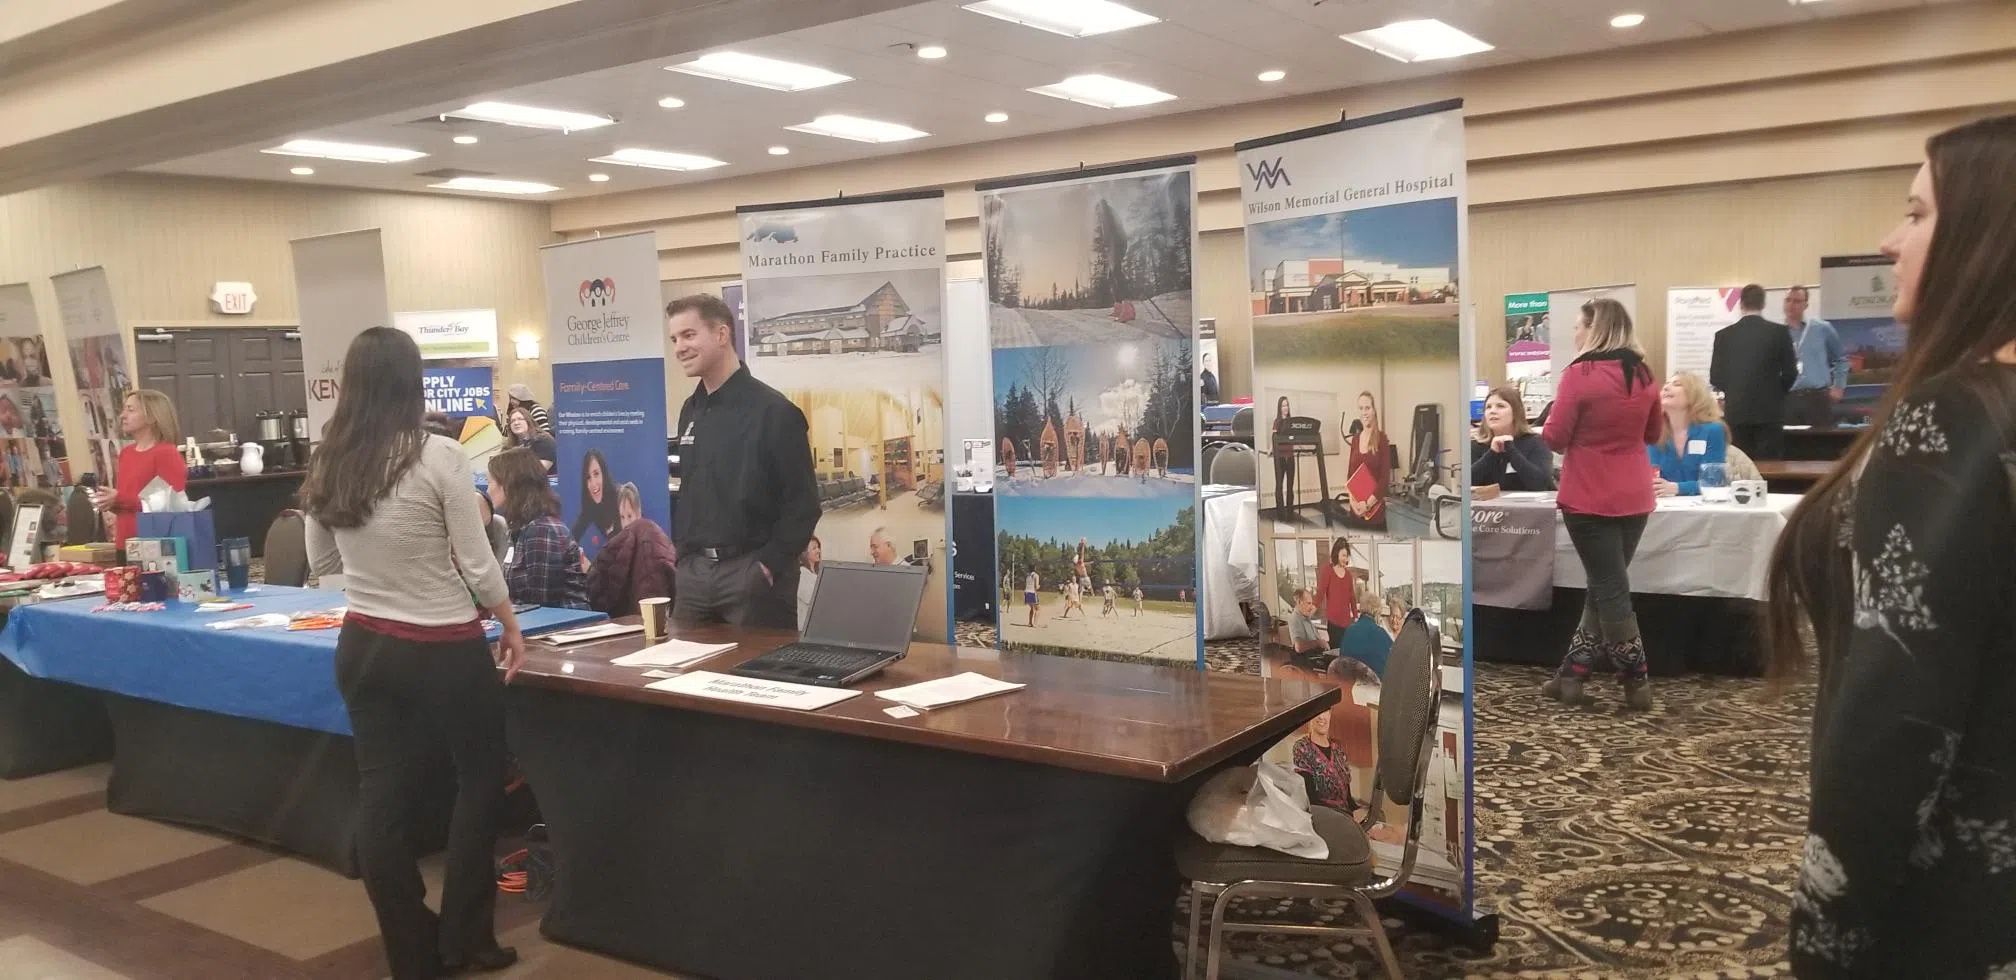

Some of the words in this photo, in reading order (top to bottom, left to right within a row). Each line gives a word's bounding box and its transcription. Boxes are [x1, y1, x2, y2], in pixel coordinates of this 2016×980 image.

[1248, 202, 1281, 215] Wilson
[1284, 191, 1339, 210] Memorial
[1344, 182, 1390, 201] General
[1395, 173, 1454, 194] Hospital
[749, 253, 815, 268] Marathon
[821, 249, 869, 264] Family
[875, 244, 937, 260] Practice
[224, 293, 247, 311] EXIT
[419, 325, 450, 335] Thunder
[454, 325, 470, 334] Bay
[568, 315, 603, 334] George
[602, 312, 630, 332] Jeffrey
[568, 332, 606, 346] Children's
[606, 331, 630, 343] Centre
[423, 376, 456, 388] PPLY
[437, 388, 461, 398] CITY
[462, 387, 491, 397] JOBS
[424, 398, 474, 412] NLINE
[1471, 510, 1504, 524] ore
[1479, 525, 1500, 533] Care
[1500, 525, 1541, 535] Solutions
[954, 571, 975, 581] Services
